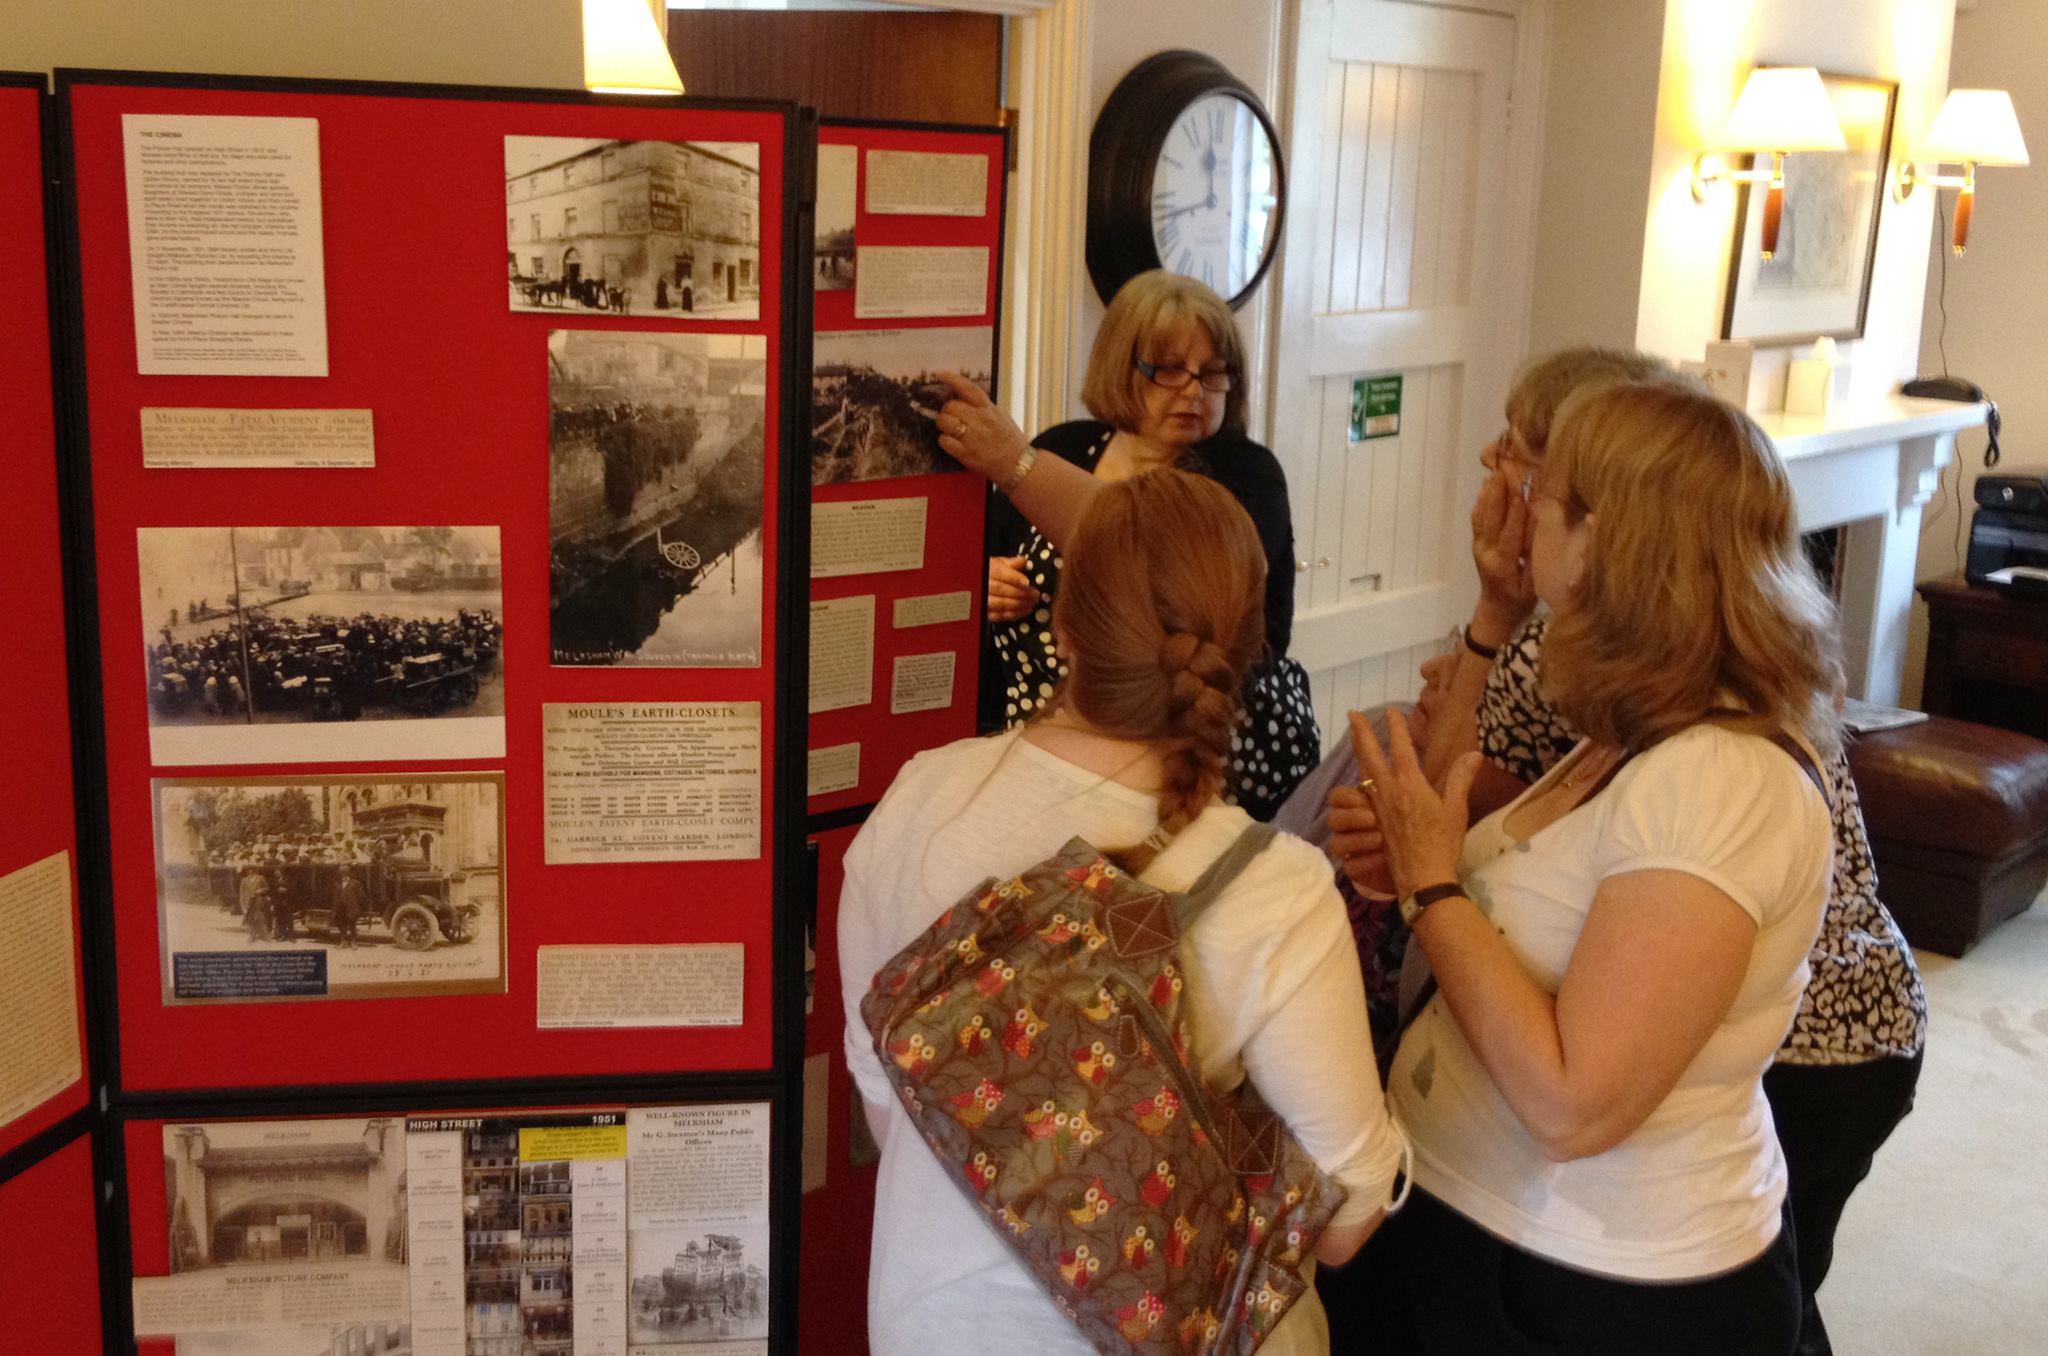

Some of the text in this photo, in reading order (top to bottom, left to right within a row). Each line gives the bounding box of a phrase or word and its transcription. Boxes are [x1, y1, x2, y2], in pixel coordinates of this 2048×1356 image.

[230, 414, 264, 425] FATAL
[568, 709, 624, 719] MOULE'S
[410, 1119, 483, 1129] HIGH STREET
[592, 1115, 616, 1123] 1951
[674, 1119, 723, 1128] MELKSHAM
[226, 1272, 349, 1284] MELKSHAM PICTURE COMPANY
